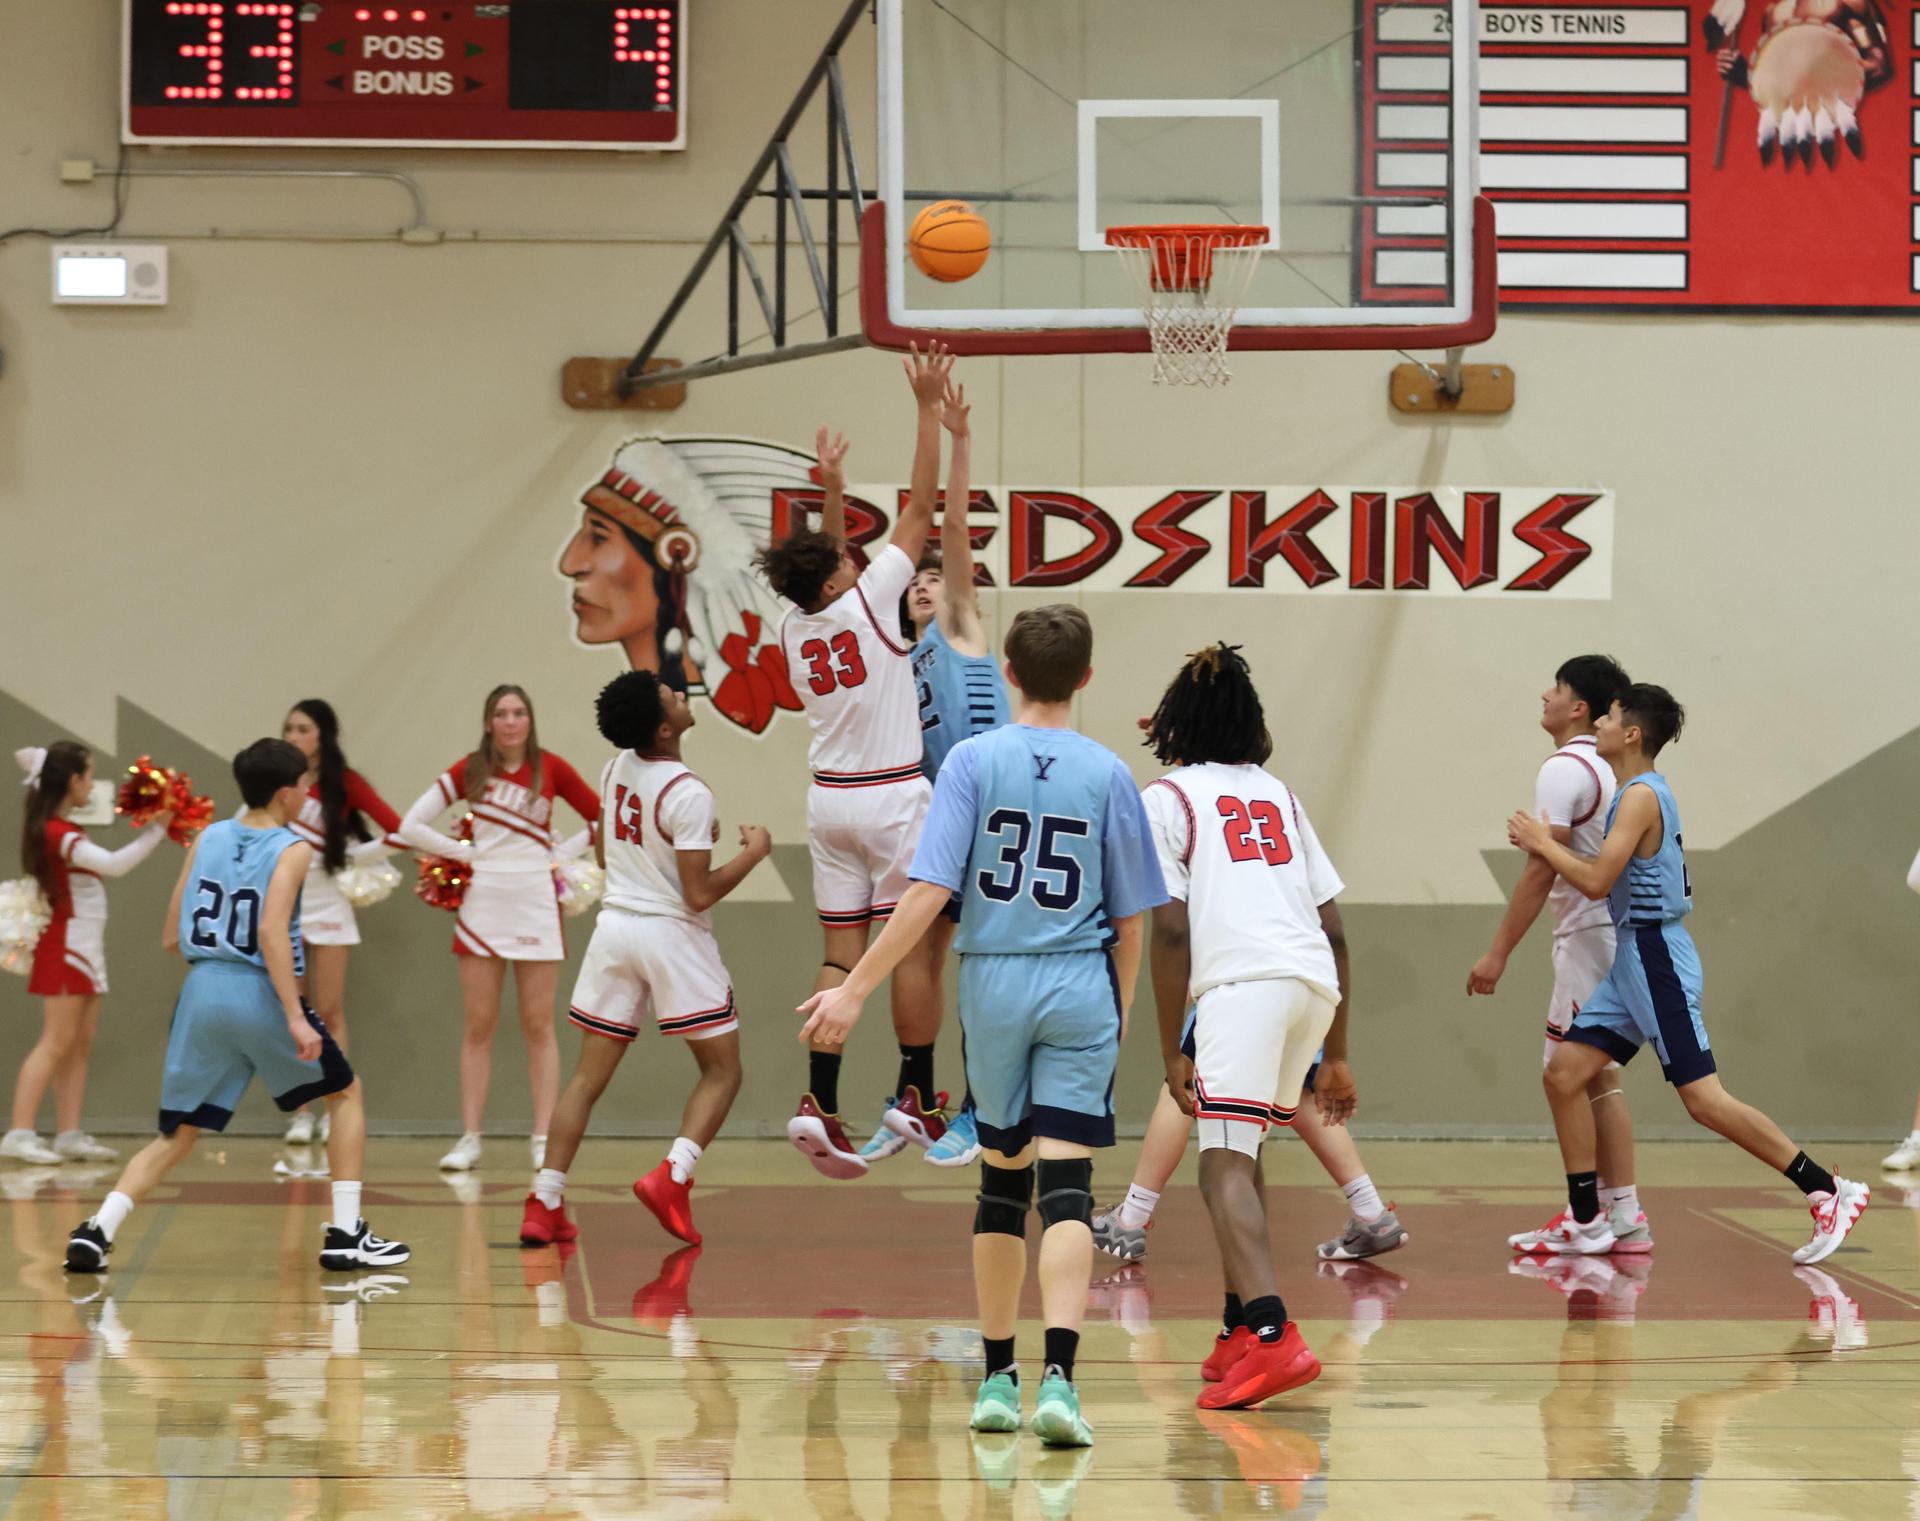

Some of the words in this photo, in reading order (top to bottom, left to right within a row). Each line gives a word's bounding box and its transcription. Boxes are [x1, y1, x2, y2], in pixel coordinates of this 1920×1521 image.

[165, 2, 294, 99] 33
[362, 35, 445, 60] POSS
[615, 8, 671, 104] 9
[1486, 14, 1543, 33] BOYS
[1551, 15, 1625, 34] TENNIS
[353, 70, 453, 95] BONUS
[801, 629, 867, 696] 33
[1033, 754, 1056, 781] Y
[976, 806, 1089, 912] 35
[1215, 795, 1293, 866] 23
[189, 876, 261, 957] 20
